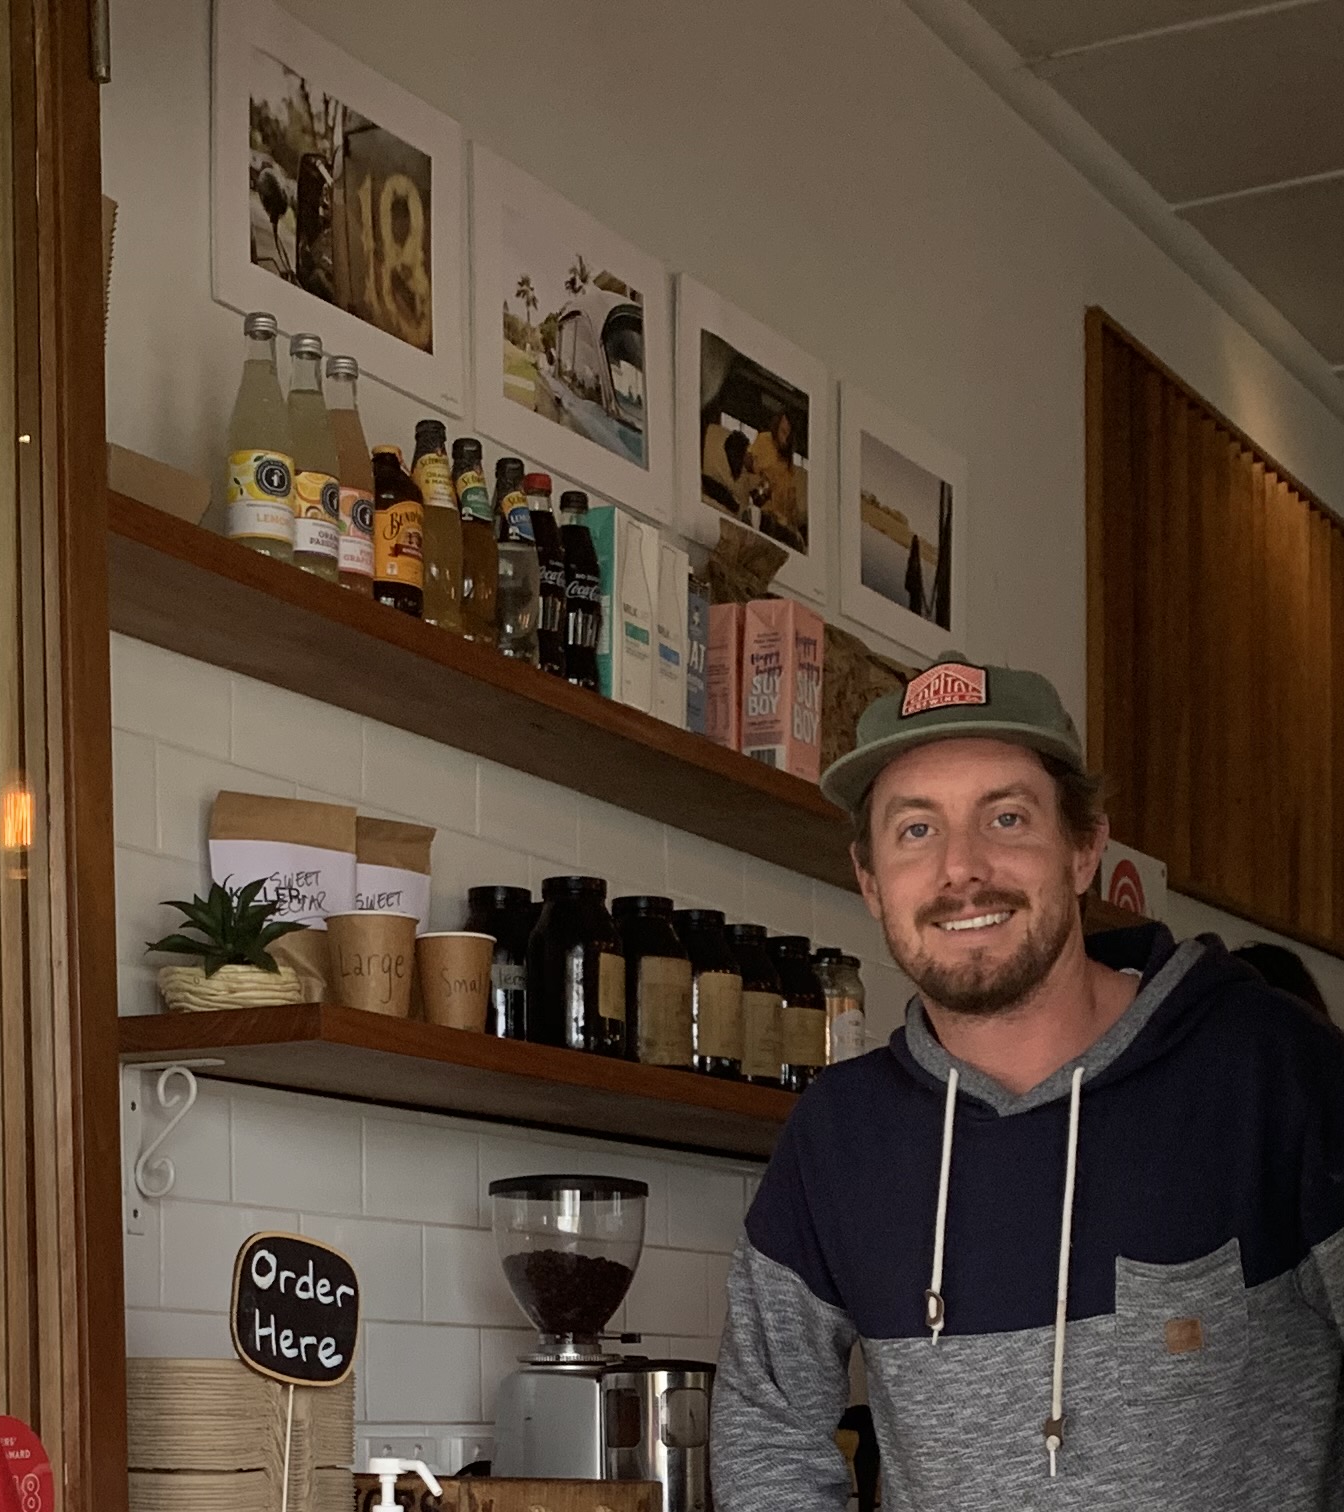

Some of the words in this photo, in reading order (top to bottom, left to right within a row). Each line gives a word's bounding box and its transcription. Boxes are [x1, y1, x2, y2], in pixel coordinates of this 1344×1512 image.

[338, 943, 405, 1005] Large
[251, 1249, 355, 1308] Order
[255, 1308, 344, 1369] Here
